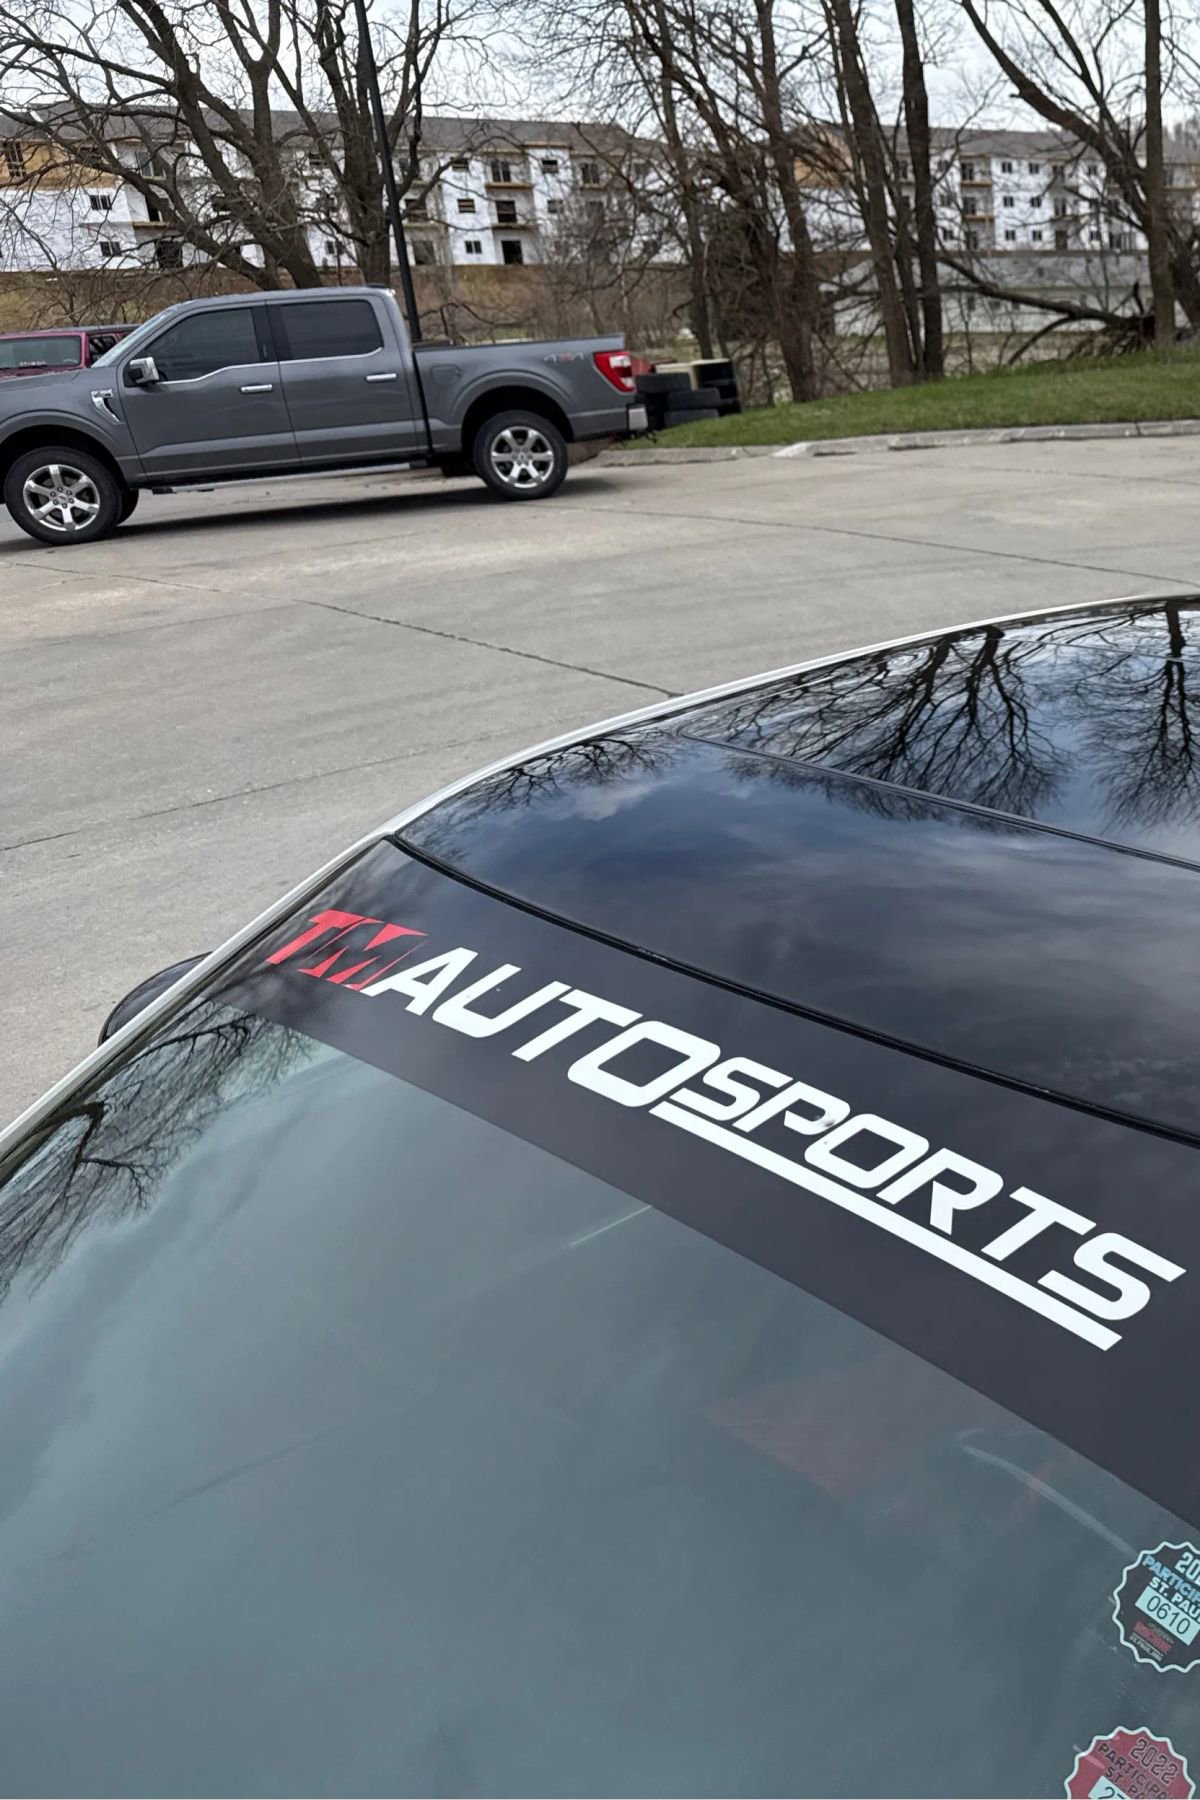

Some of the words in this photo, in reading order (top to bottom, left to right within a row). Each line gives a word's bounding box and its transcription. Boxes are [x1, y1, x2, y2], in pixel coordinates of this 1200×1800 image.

[359, 947, 1187, 1322] AUTOSPORTS
[1149, 1576, 1169, 1597] ST.
[1146, 1595, 1191, 1635] 0610
[1129, 1737, 1179, 1786] 2022
